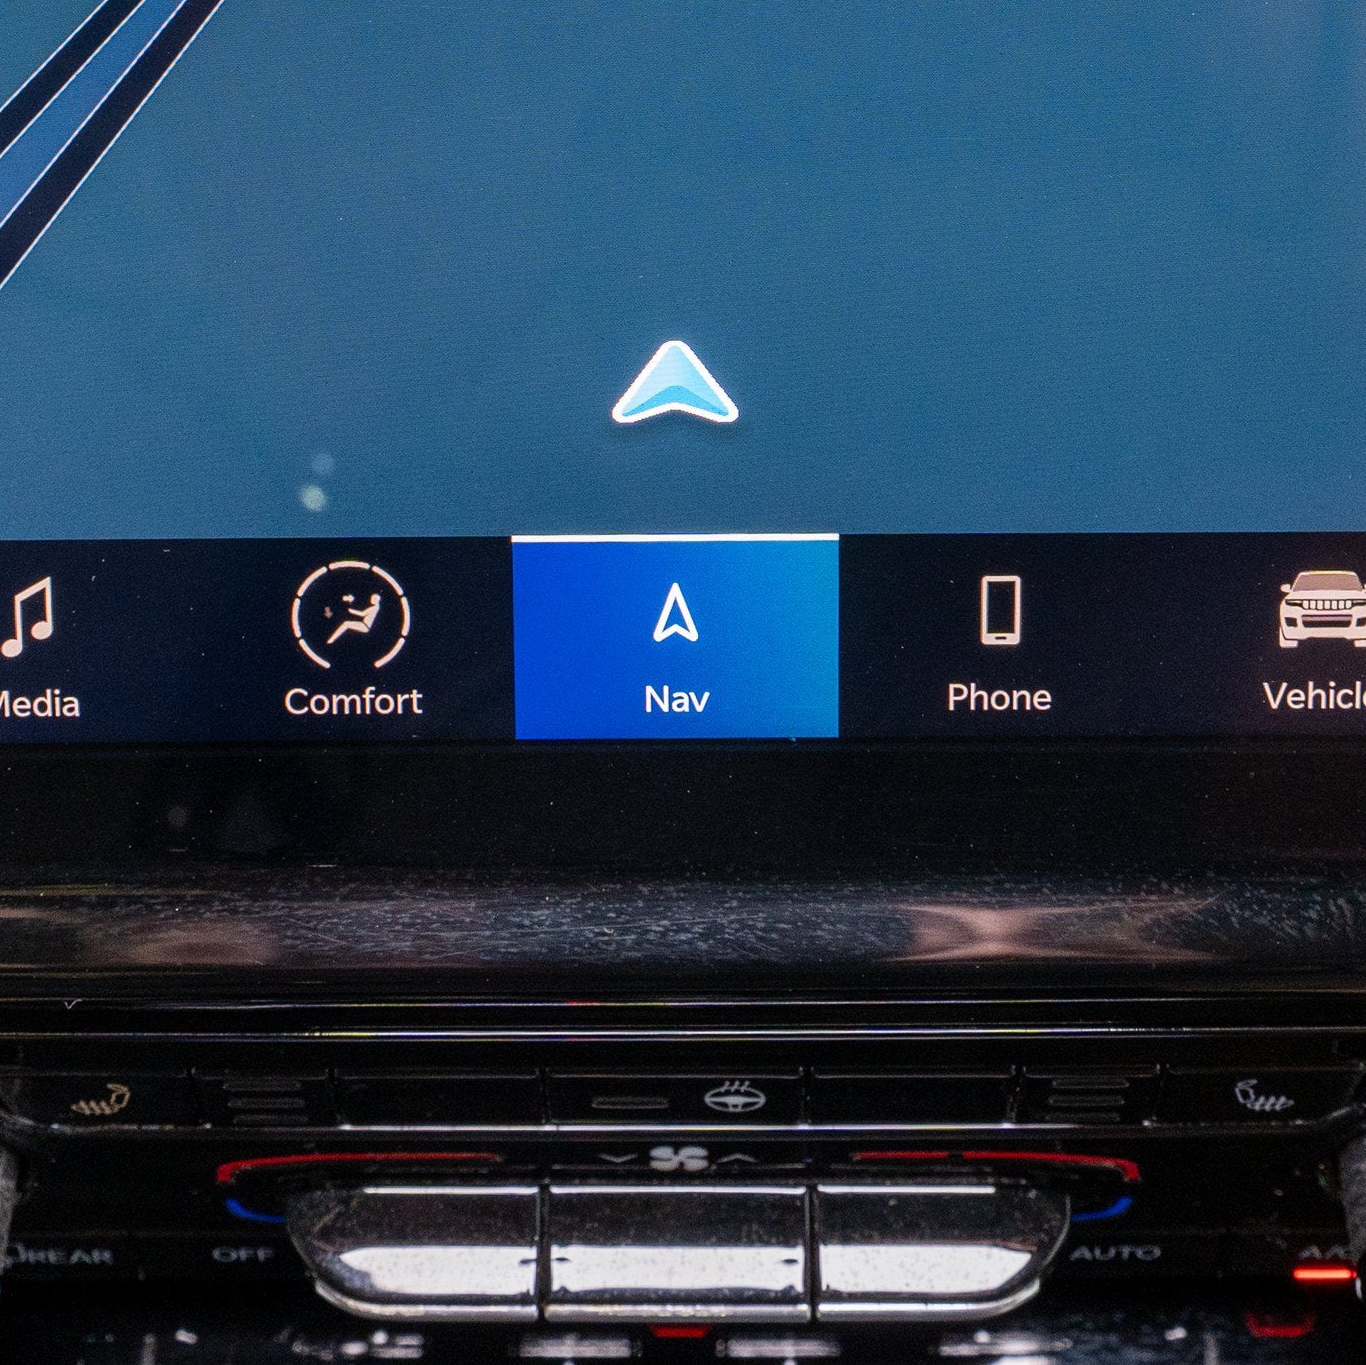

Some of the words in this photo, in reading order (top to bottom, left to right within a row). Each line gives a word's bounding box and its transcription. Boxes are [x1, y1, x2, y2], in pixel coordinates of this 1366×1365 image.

[284, 687, 422, 717] Comfort
[644, 686, 710, 713] Nav
[948, 683, 1051, 712] Phone
[1070, 1245, 1161, 1261] AUTO
